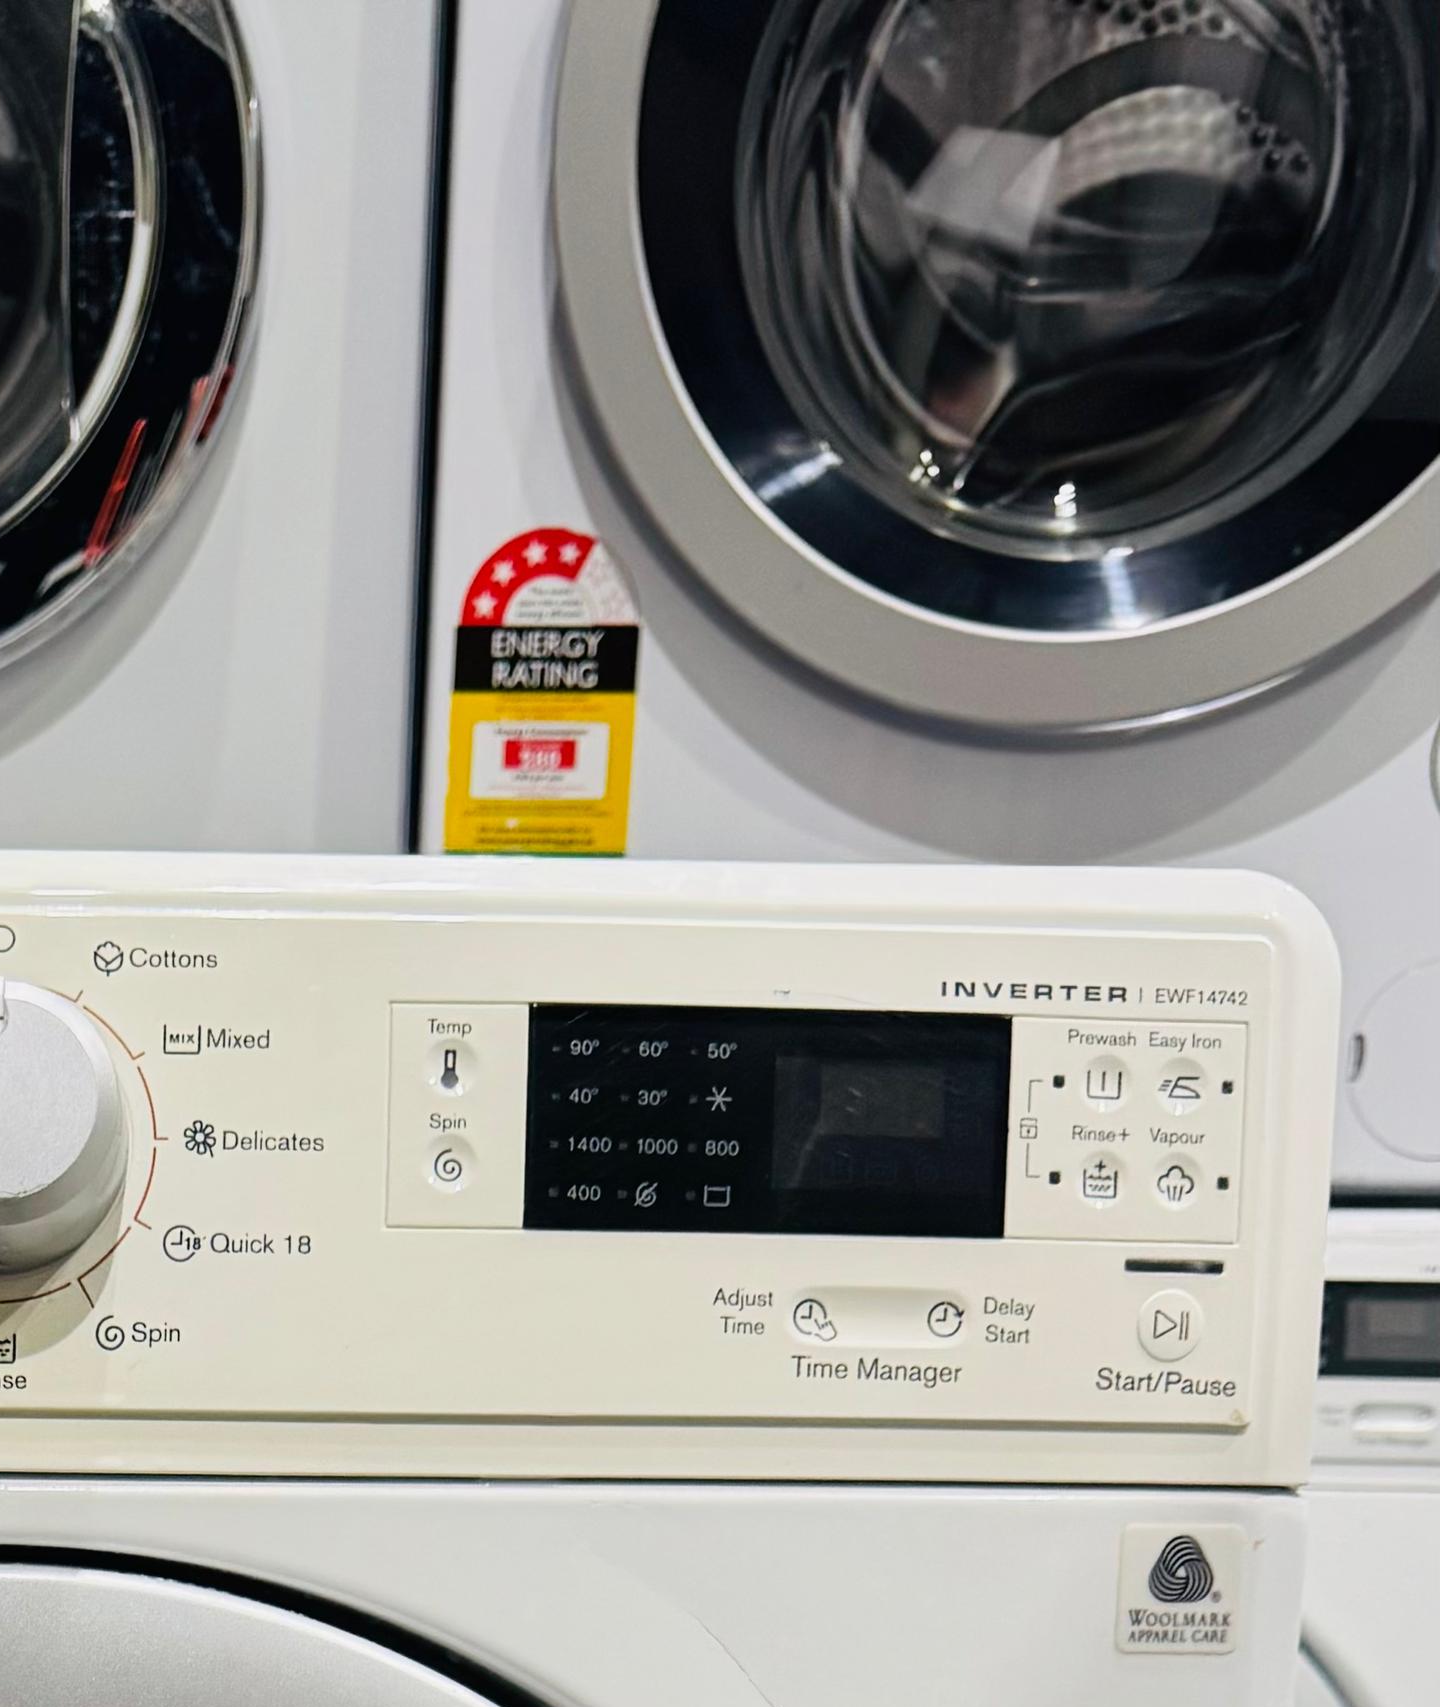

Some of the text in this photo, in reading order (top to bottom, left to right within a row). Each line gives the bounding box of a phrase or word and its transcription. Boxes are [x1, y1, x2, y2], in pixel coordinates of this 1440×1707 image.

[491, 630, 605, 659] ENERGY
[491, 660, 599, 690] RATING
[129, 947, 218, 968] Cottons
[941, 981, 1128, 1003] INVERTER
[1155, 987, 1249, 1006] EWF14742
[169, 1033, 195, 1044] MIX
[207, 1029, 270, 1049] Mixed
[427, 1018, 472, 1039] Temp
[1067, 1029, 1137, 1047] Prewash
[1149, 1032, 1222, 1052] Easy Iron
[429, 1113, 467, 1133] Spin
[222, 1130, 325, 1152] Delicates
[1072, 1126, 1131, 1142] Rinse+
[1150, 1128, 1205, 1149] Vapour
[568, 1136, 739, 1157] 1400 1000 800
[567, 1185, 601, 1202] 400
[210, 1232, 311, 1255] Quick 18
[713, 1288, 773, 1310] Adjust
[984, 1297, 1035, 1322] Delay
[131, 1322, 180, 1347] Spin
[720, 1316, 765, 1336] Time
[985, 1325, 1030, 1345] Start
[791, 1355, 963, 1388] Time Manager
[1095, 1368, 1237, 1398] Start/Pause
[1128, 1629, 1228, 1644] APPAREL CARE
